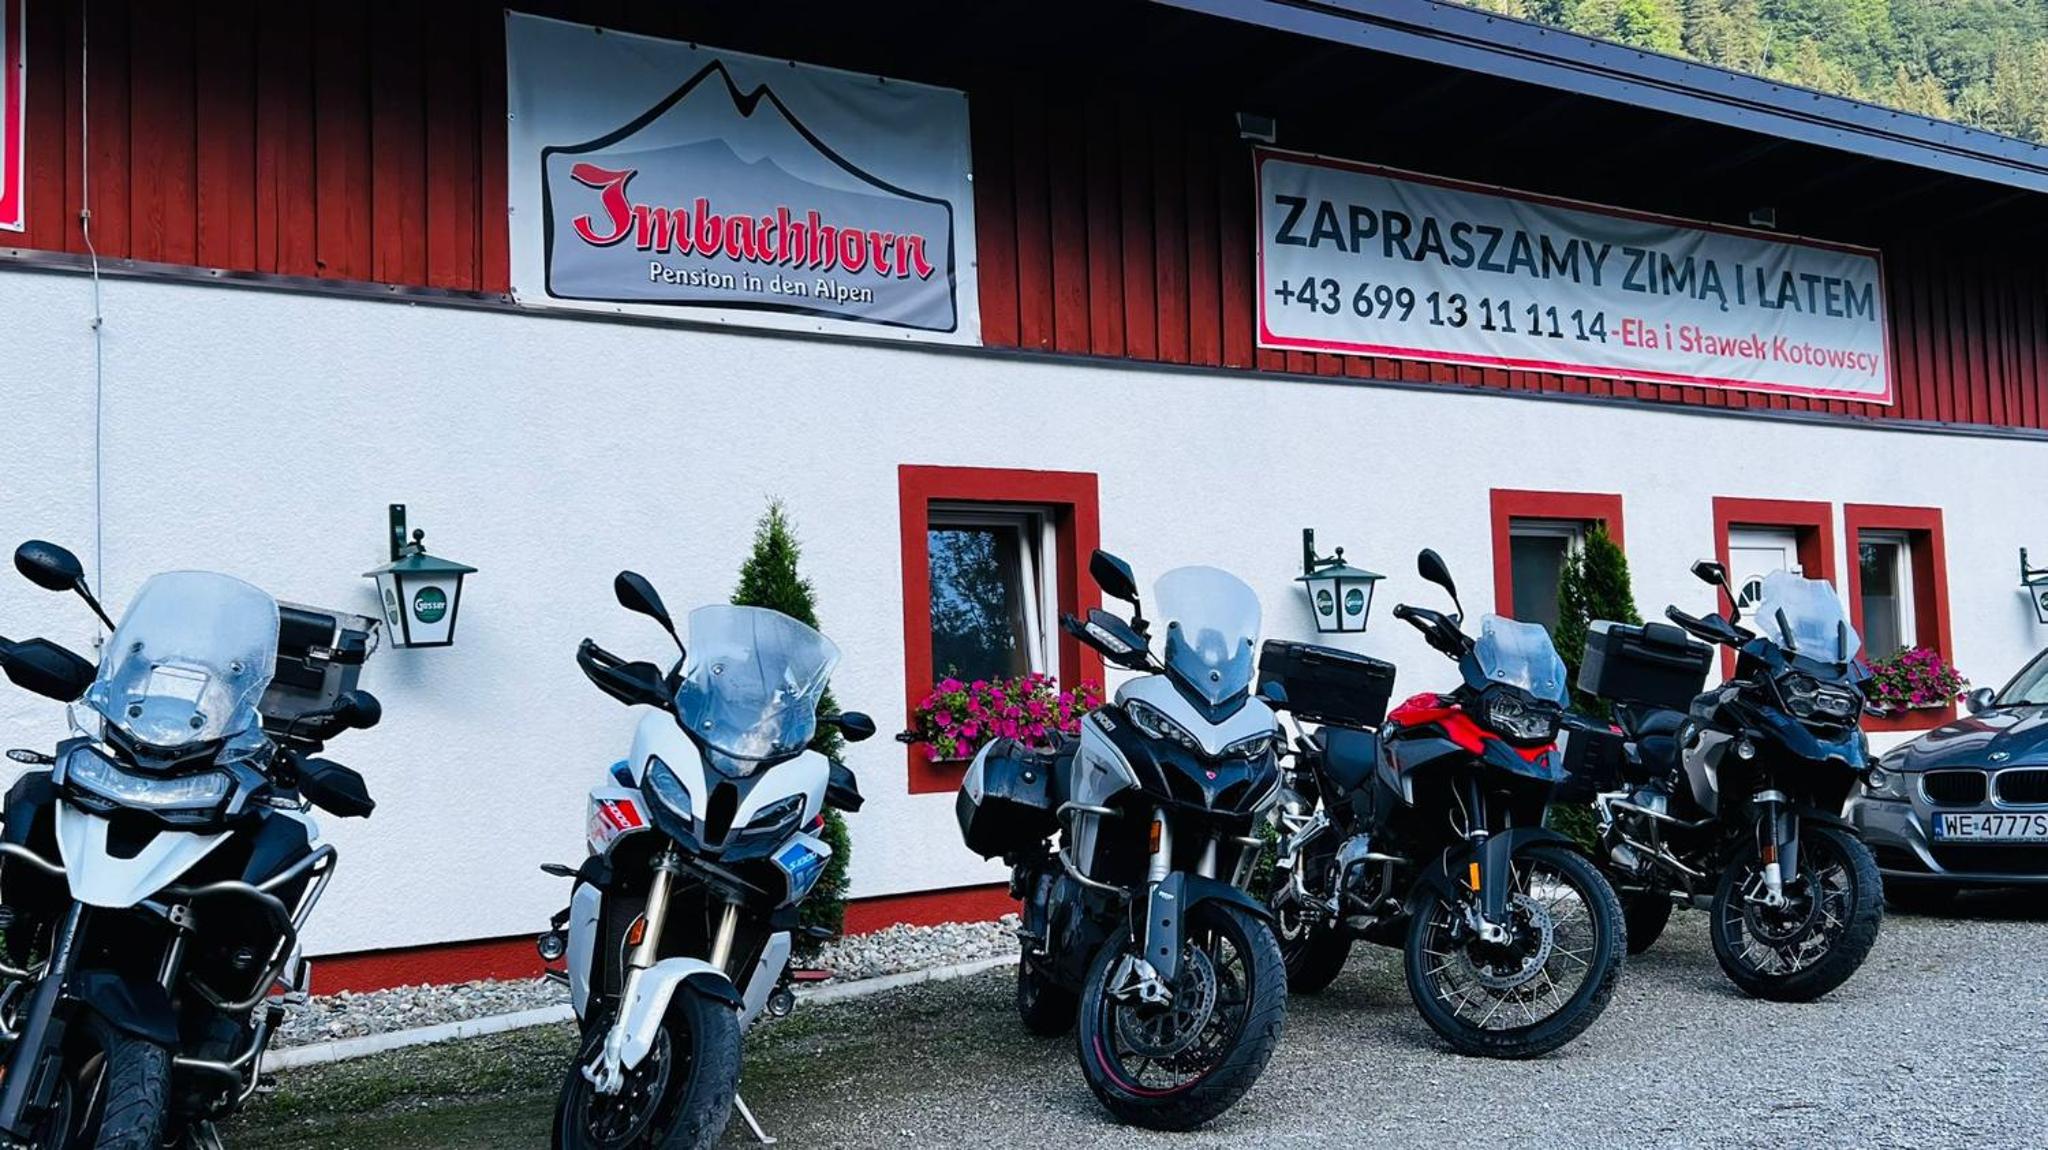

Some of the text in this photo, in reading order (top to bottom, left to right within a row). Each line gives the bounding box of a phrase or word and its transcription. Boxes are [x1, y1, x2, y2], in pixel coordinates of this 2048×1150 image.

[571, 162, 934, 281] Imbachhorn
[1275, 194, 1876, 322] ZAPRASZAMY ZIMĄ I LATEM
[650, 261, 873, 305] Pension in den Alpen
[1275, 276, 1342, 315] +43
[1352, 282, 1416, 322] 699
[1426, 291, 1468, 328] 13
[1479, 297, 1517, 333] 11
[1526, 303, 1564, 338] 11
[1664, 323, 1673, 351] i
[1679, 325, 1767, 360] Sławek
[1772, 335, 1879, 378] Kotowscy
[1944, 815, 1974, 836] WE
[1981, 815, 2047, 836] 4777S
